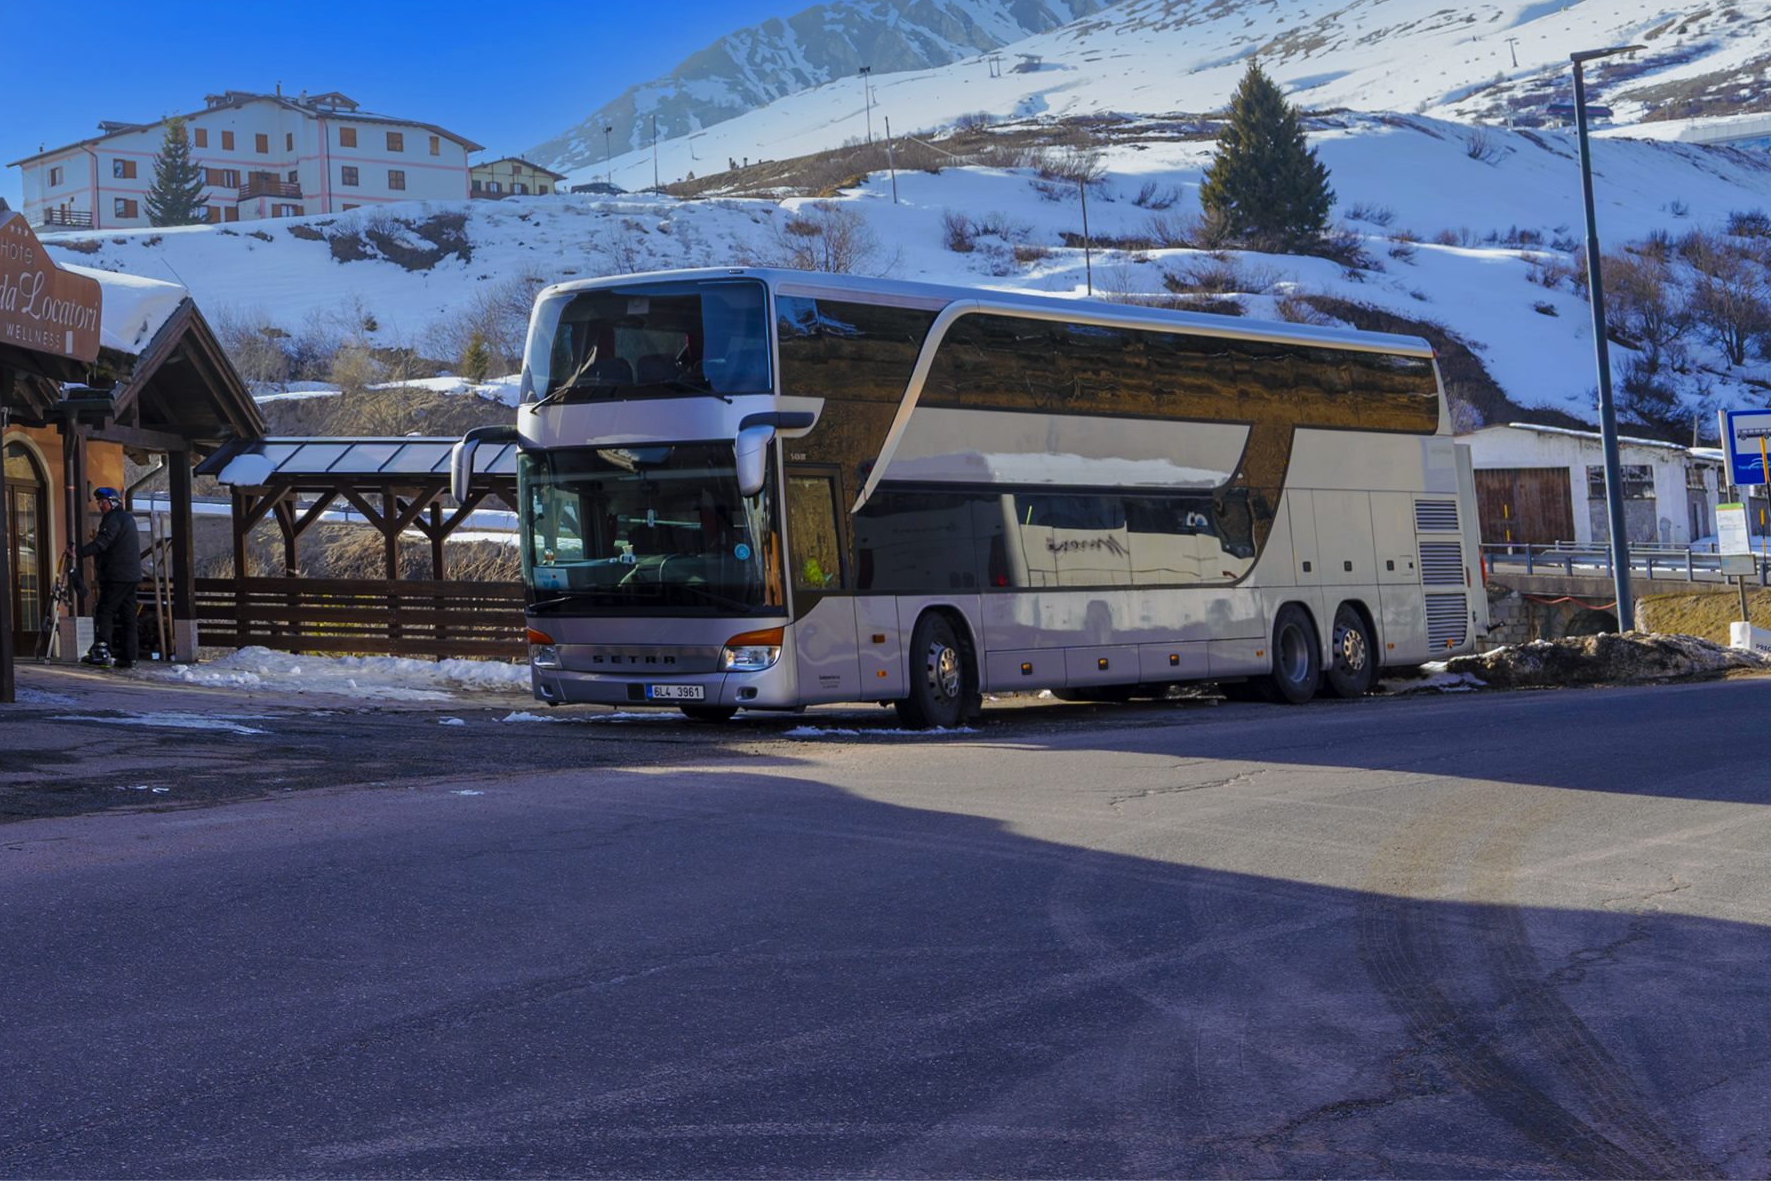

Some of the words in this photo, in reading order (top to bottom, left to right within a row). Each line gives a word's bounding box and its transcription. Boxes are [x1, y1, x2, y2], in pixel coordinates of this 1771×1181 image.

[19, 271, 98, 332] Locatori
[6, 322, 61, 349] WELLNESS
[592, 655, 676, 664] SETRA
[654, 686, 671, 697] 6L4
[677, 687, 700, 698] 3961
